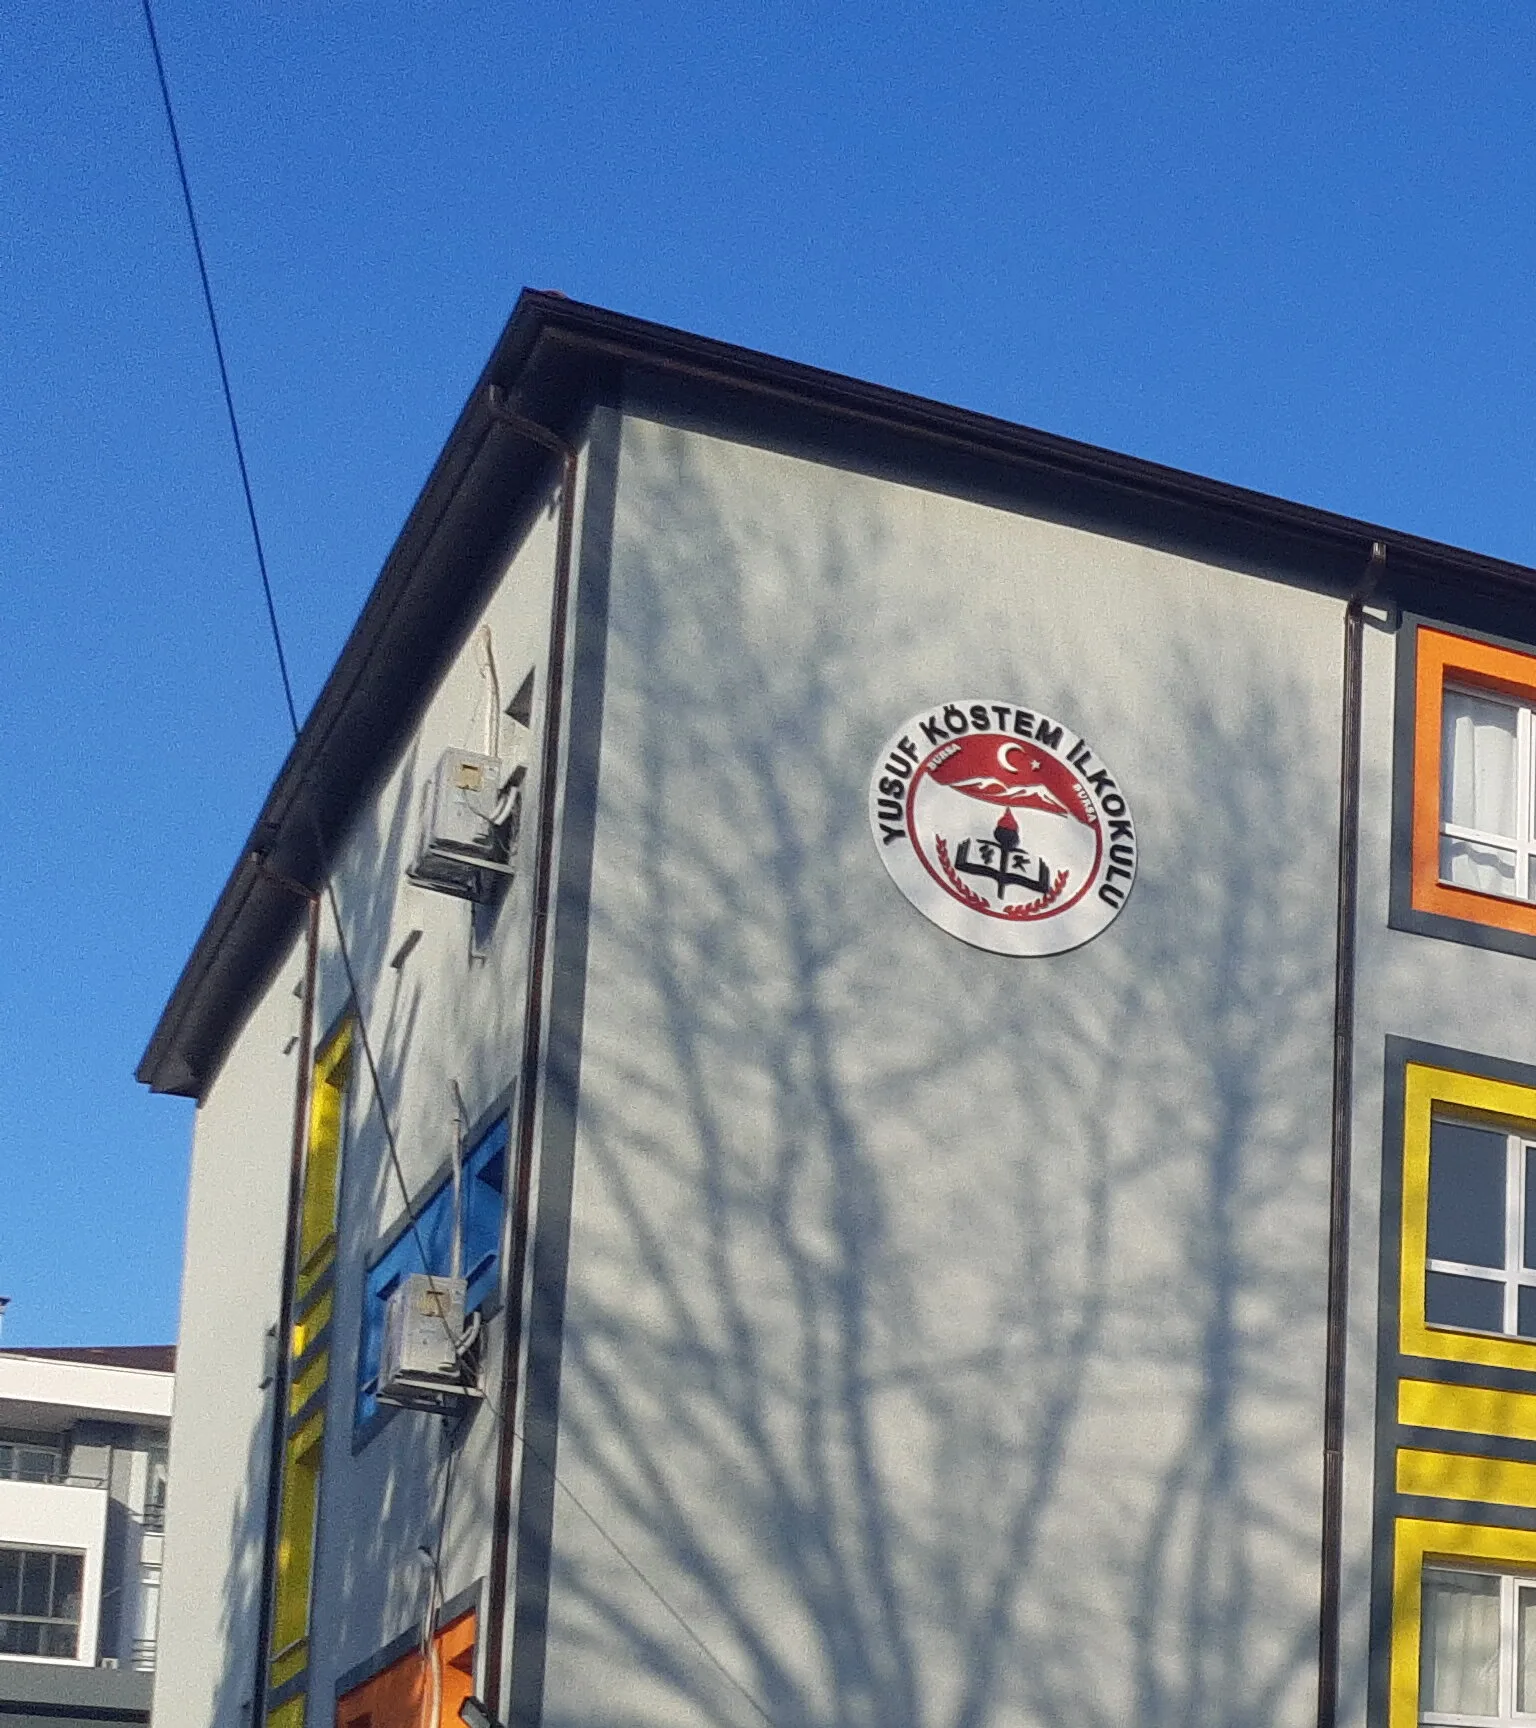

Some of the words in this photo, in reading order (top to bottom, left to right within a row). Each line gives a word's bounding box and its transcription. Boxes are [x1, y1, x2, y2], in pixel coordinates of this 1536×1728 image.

[877, 735, 920, 846] YUSUF
[919, 704, 1063, 751] KÖSTEM
[1066, 738, 1135, 910] İLKOKULU
